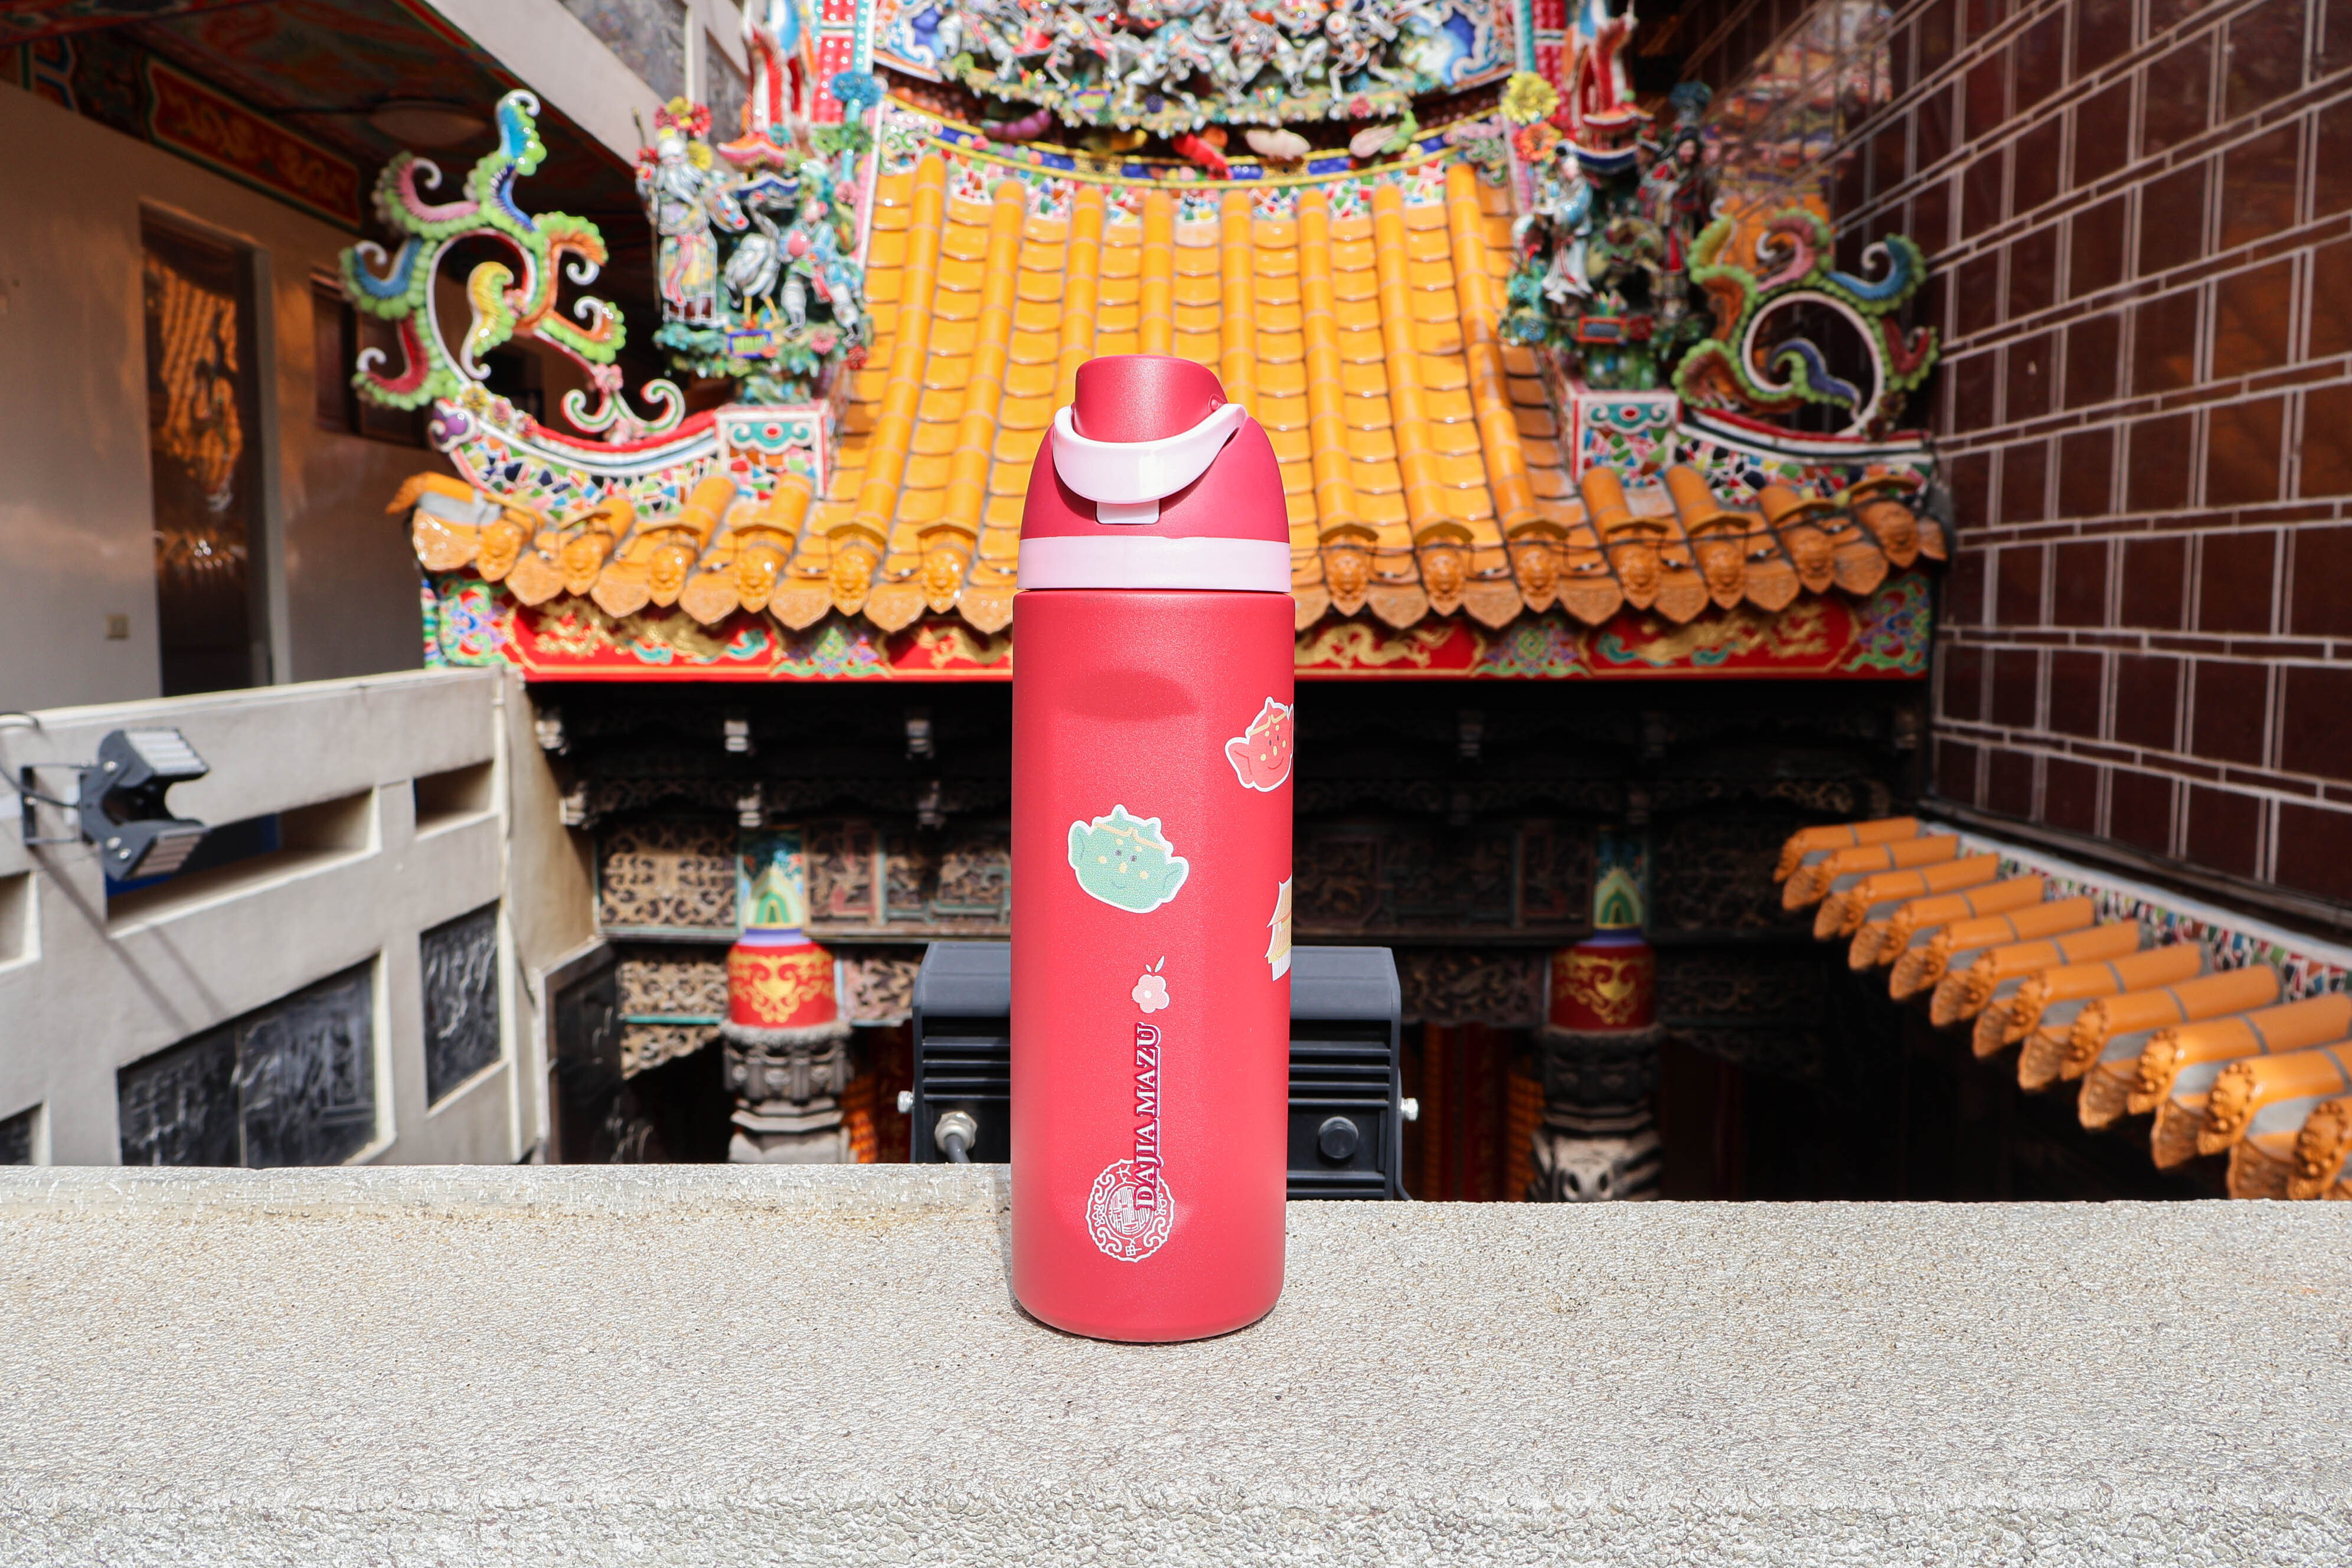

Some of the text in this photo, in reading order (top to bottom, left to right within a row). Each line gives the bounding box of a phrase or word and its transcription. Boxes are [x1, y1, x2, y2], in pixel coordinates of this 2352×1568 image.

[1133, 1023, 1162, 1210] DAJIA MAZU
[1116, 1165, 1142, 1256] 大 甲
